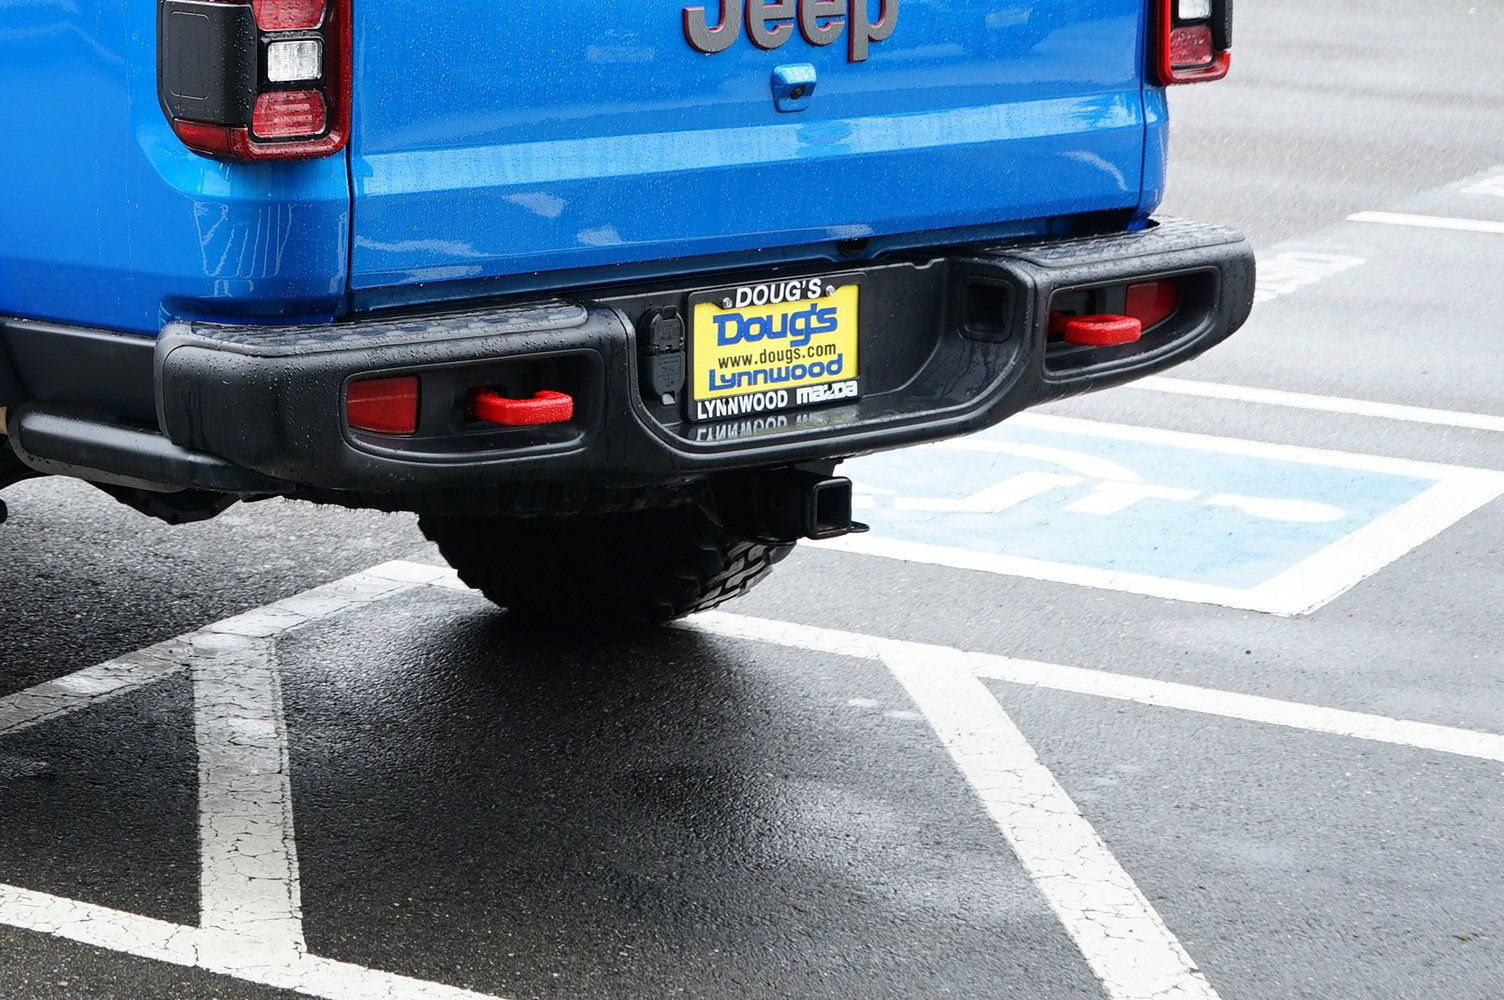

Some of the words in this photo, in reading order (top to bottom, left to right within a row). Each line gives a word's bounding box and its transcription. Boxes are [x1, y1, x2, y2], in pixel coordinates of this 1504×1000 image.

[735, 278, 822, 308] DOUG'S
[713, 303, 838, 347] Doug's
[718, 344, 837, 369] www.dougs.com
[708, 353, 843, 391] Lynnwood
[697, 390, 788, 420] LYNNWOOD
